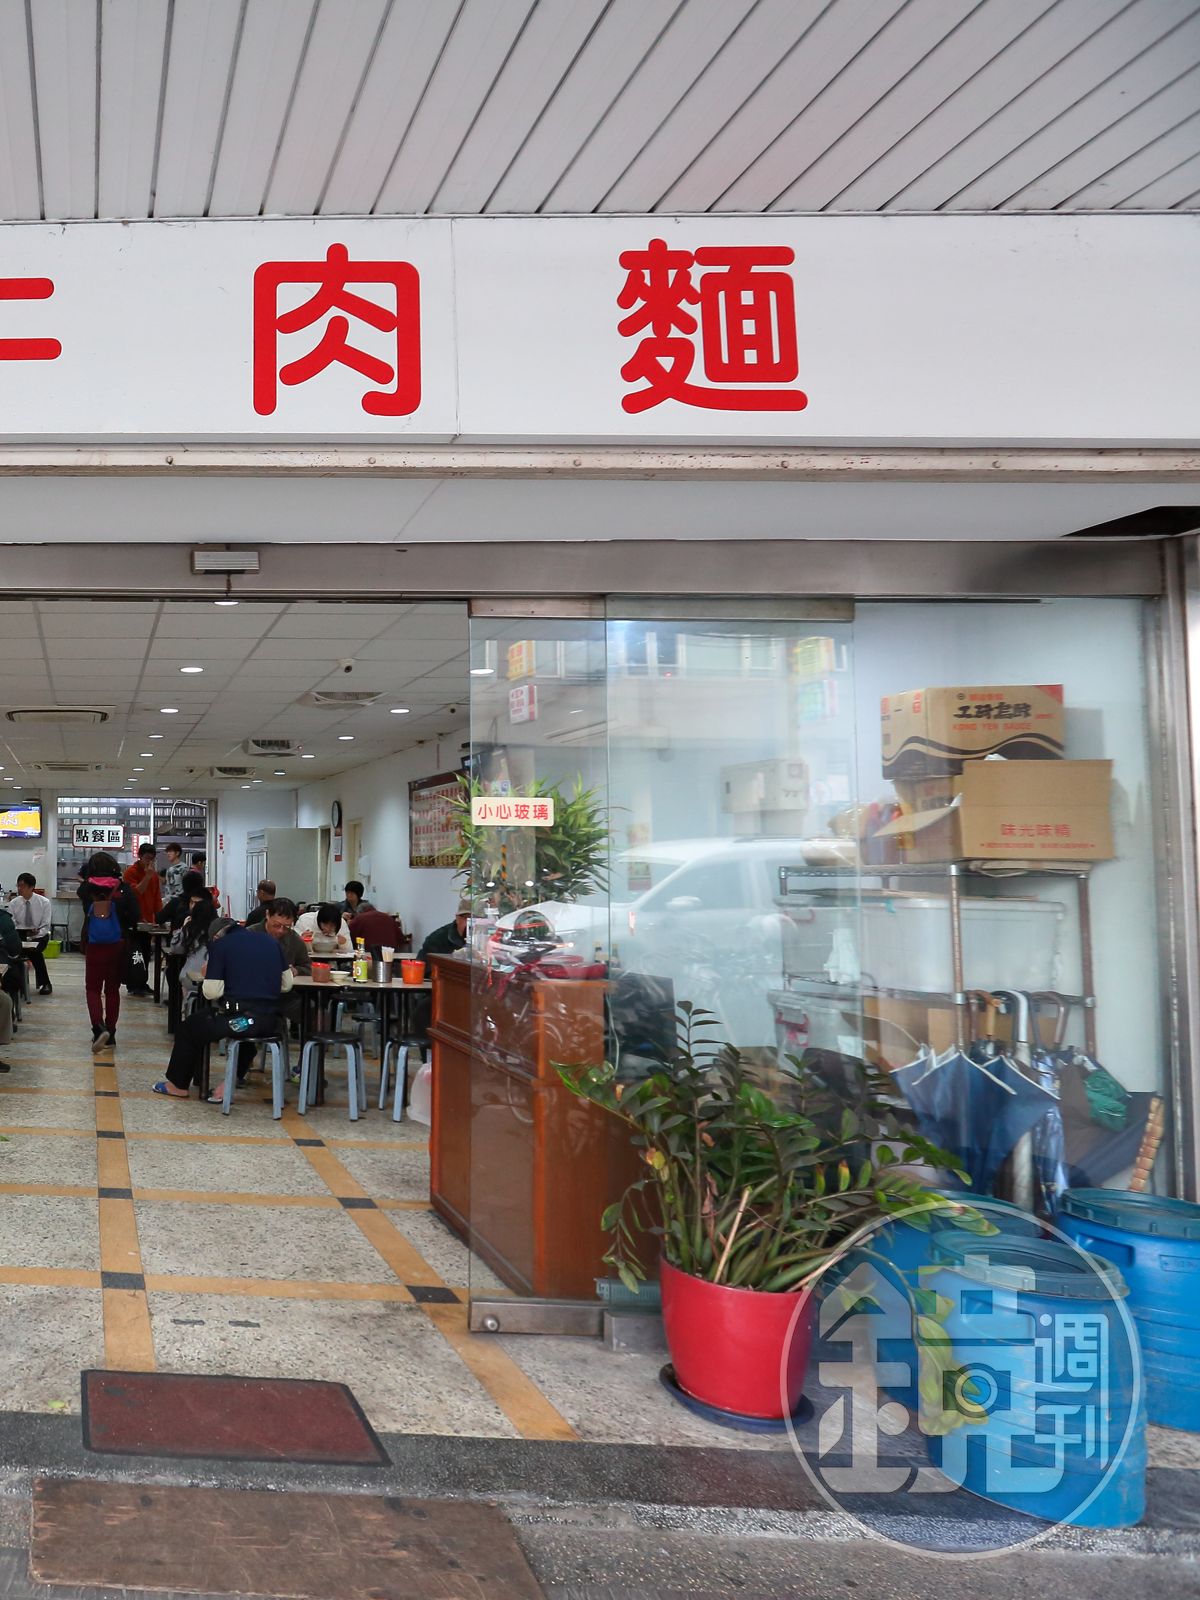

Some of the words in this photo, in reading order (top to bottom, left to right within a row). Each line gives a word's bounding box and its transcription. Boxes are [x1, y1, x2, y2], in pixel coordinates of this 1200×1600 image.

[477, 803, 549, 821] 小心玻璃
[75, 829, 121, 844] 點餐區
